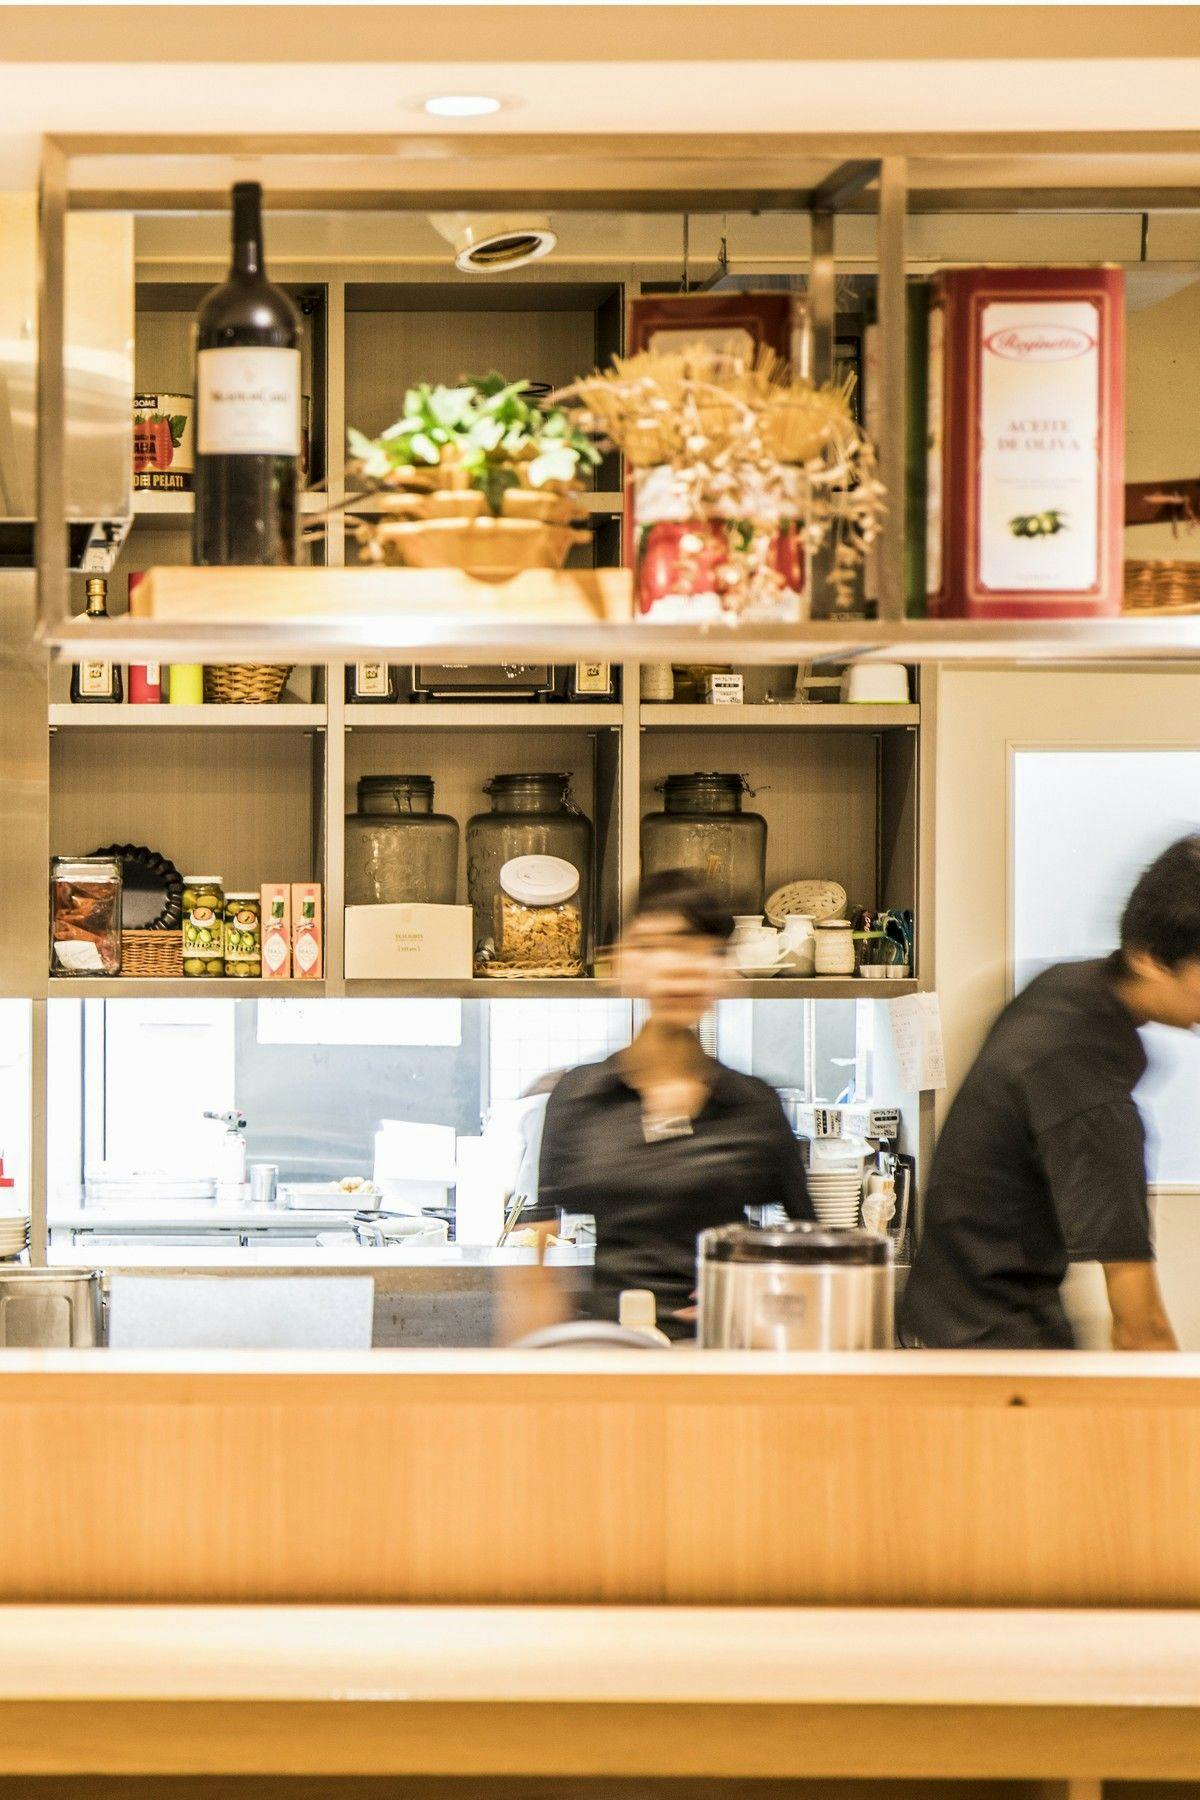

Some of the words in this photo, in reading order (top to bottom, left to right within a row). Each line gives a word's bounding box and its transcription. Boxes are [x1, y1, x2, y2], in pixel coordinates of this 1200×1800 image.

[1008, 420, 1069, 433] ACEITE
[998, 438, 1018, 451] DE
[1023, 438, 1081, 451] OLIVA
